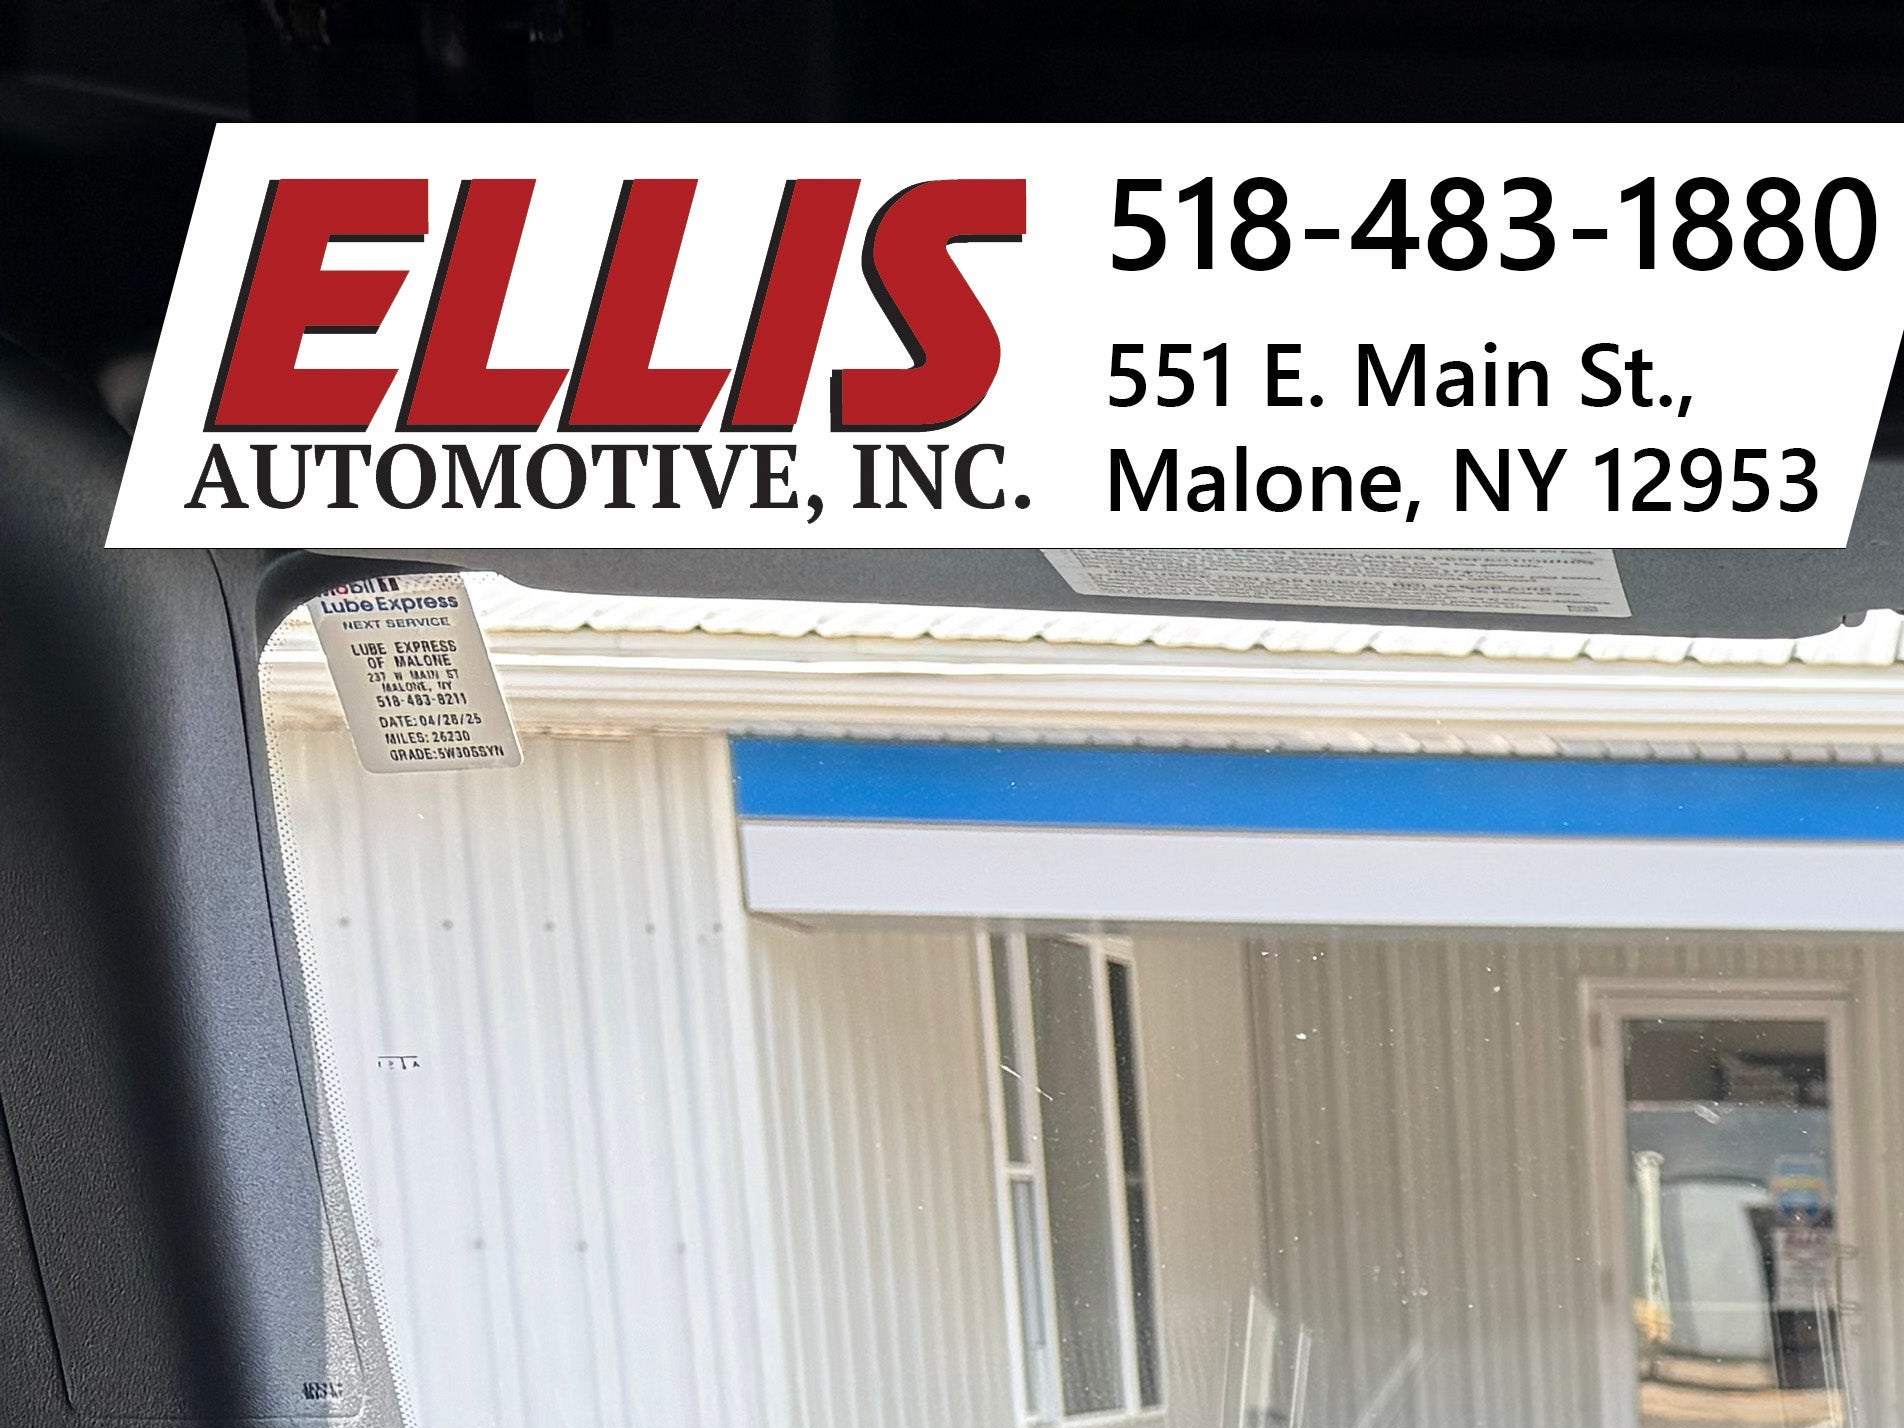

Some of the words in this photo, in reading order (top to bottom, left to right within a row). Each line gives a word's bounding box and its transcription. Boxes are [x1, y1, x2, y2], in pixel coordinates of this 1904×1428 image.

[322, 579, 375, 596] obil
[321, 598, 373, 614] Lube
[377, 596, 459, 613] Express
[343, 619, 380, 630] NEXT
[386, 617, 450, 628] SERVICE
[351, 643, 387, 656] LUBE
[394, 640, 457, 654] EXPRESS
[367, 657, 385, 669] OF
[394, 654, 452, 667] MALONE
[367, 672, 386, 682] 237
[410, 670, 439, 680] MAIN
[376, 692, 467, 708] 518-483-8211
